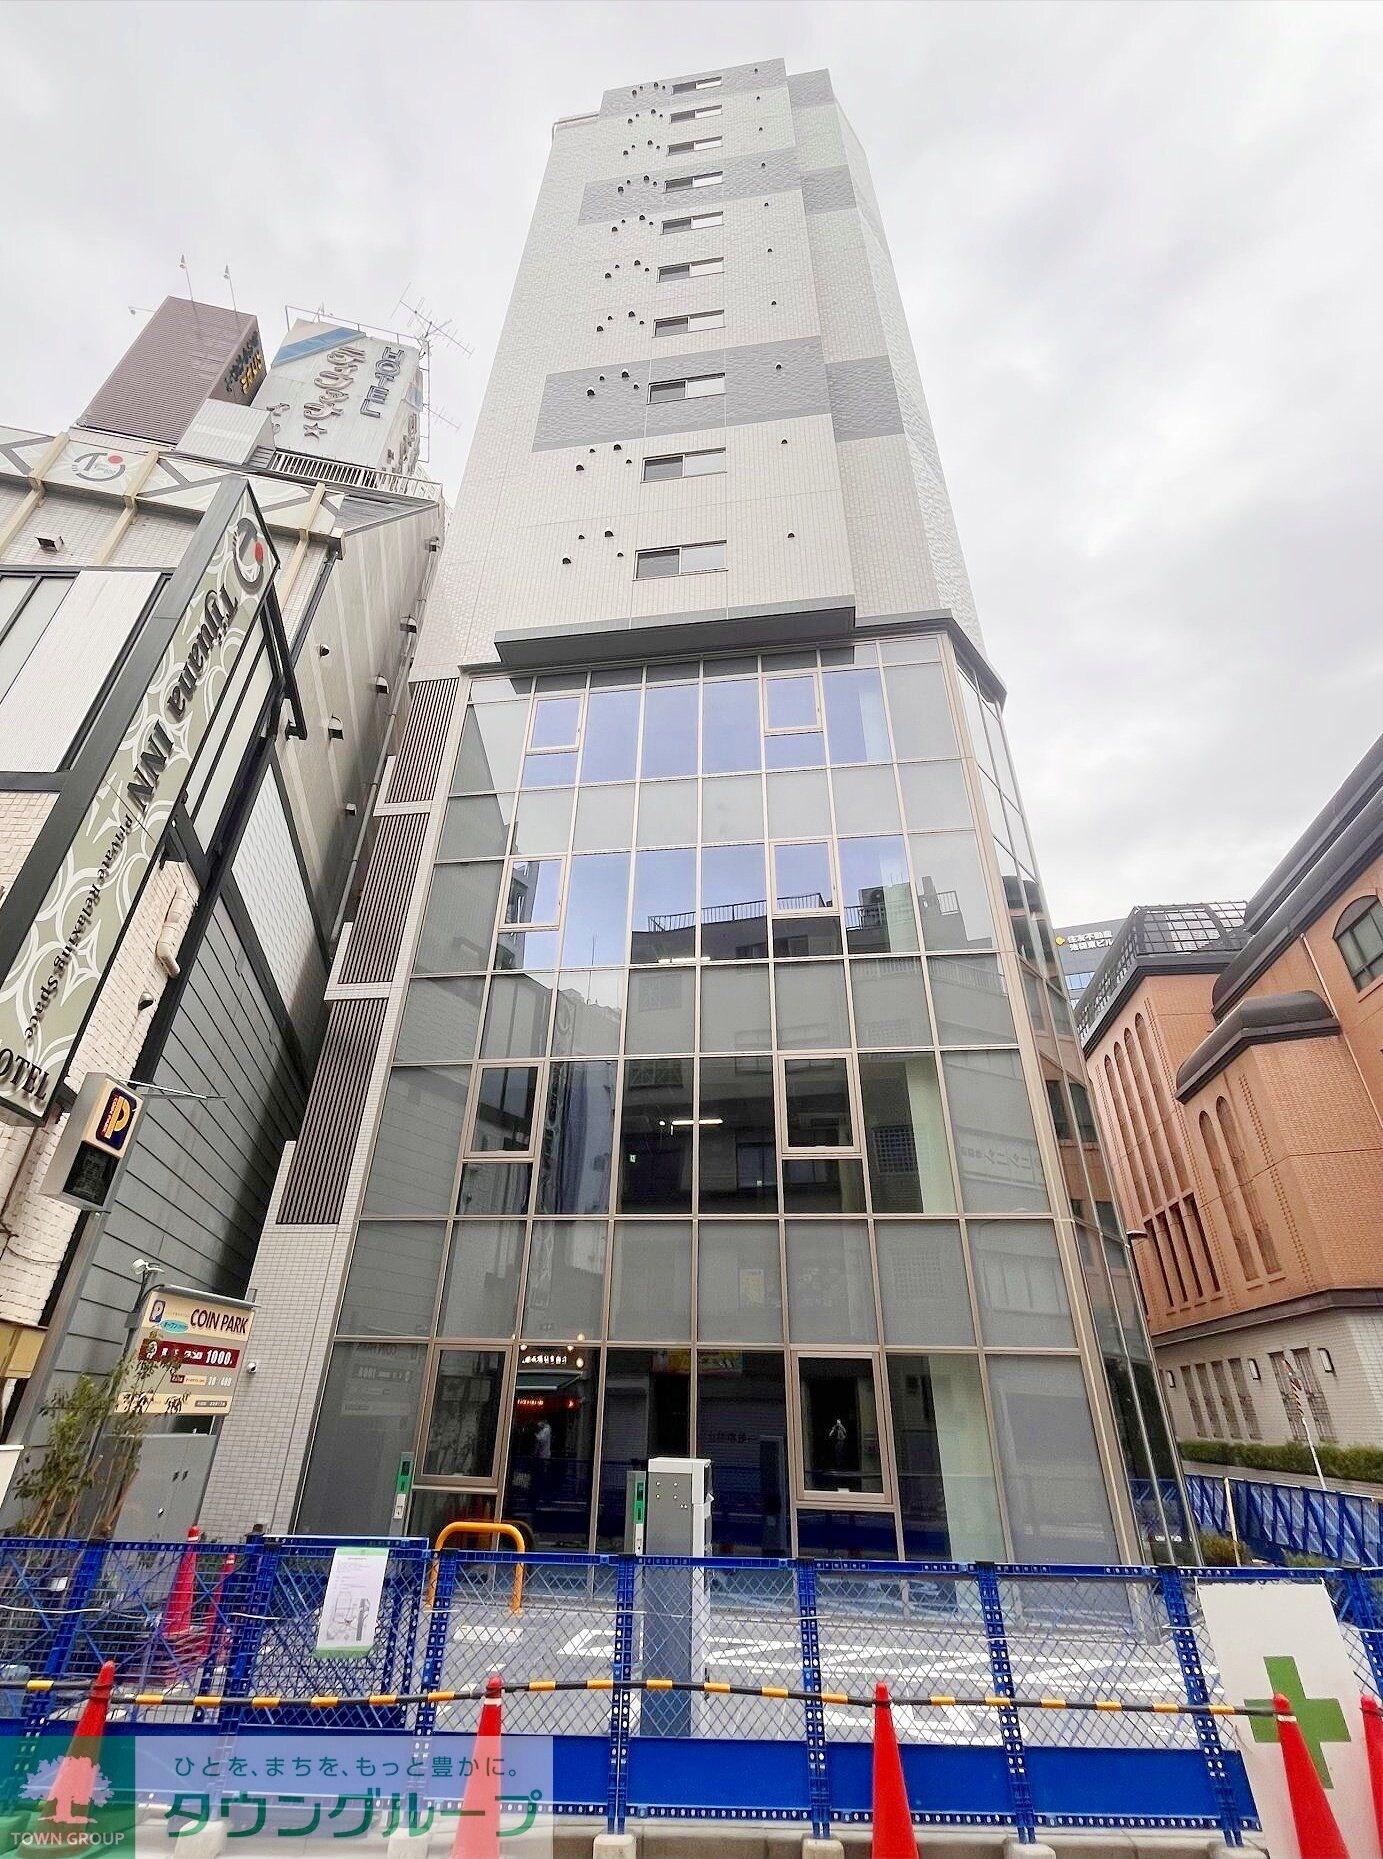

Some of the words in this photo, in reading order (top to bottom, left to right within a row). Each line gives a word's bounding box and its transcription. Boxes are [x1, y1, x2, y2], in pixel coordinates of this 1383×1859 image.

[359, 346, 405, 419] HOTEL
[166, 583, 239, 722] Tijuana
[126, 719, 174, 814] INN
[97, 813, 133, 881] Private
[53, 884, 101, 970] Relaxing
[25, 975, 59, 1039] Space
[190, 1308, 220, 1330] COIN
[220, 1314, 250, 1334] PARK
